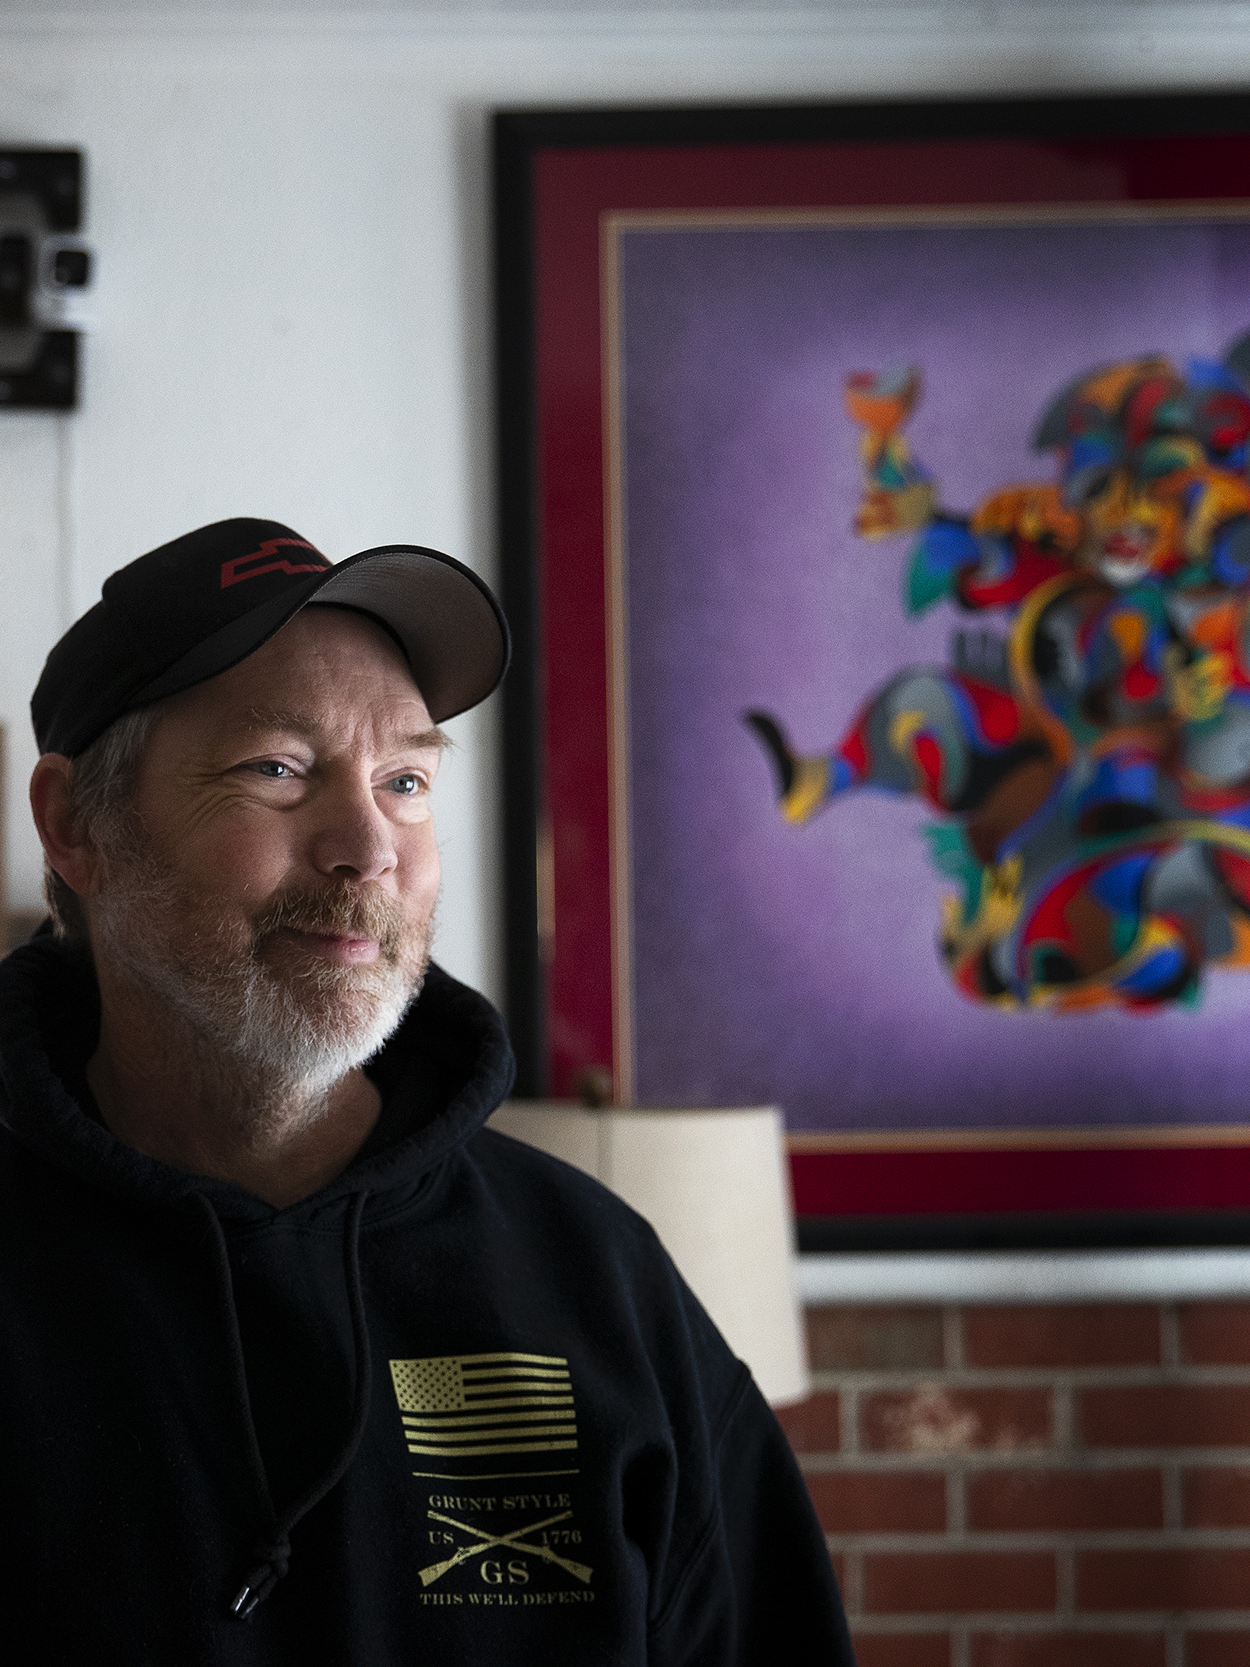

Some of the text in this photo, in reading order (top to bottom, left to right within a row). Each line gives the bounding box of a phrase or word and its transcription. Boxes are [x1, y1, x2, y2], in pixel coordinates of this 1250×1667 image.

[428, 1493, 571, 1511] GRUNT STYLE
[427, 1529, 583, 1545] US 1776
[480, 1559, 530, 1585] GS
[419, 1590, 595, 1606] THIS WE'LL DEFEND
